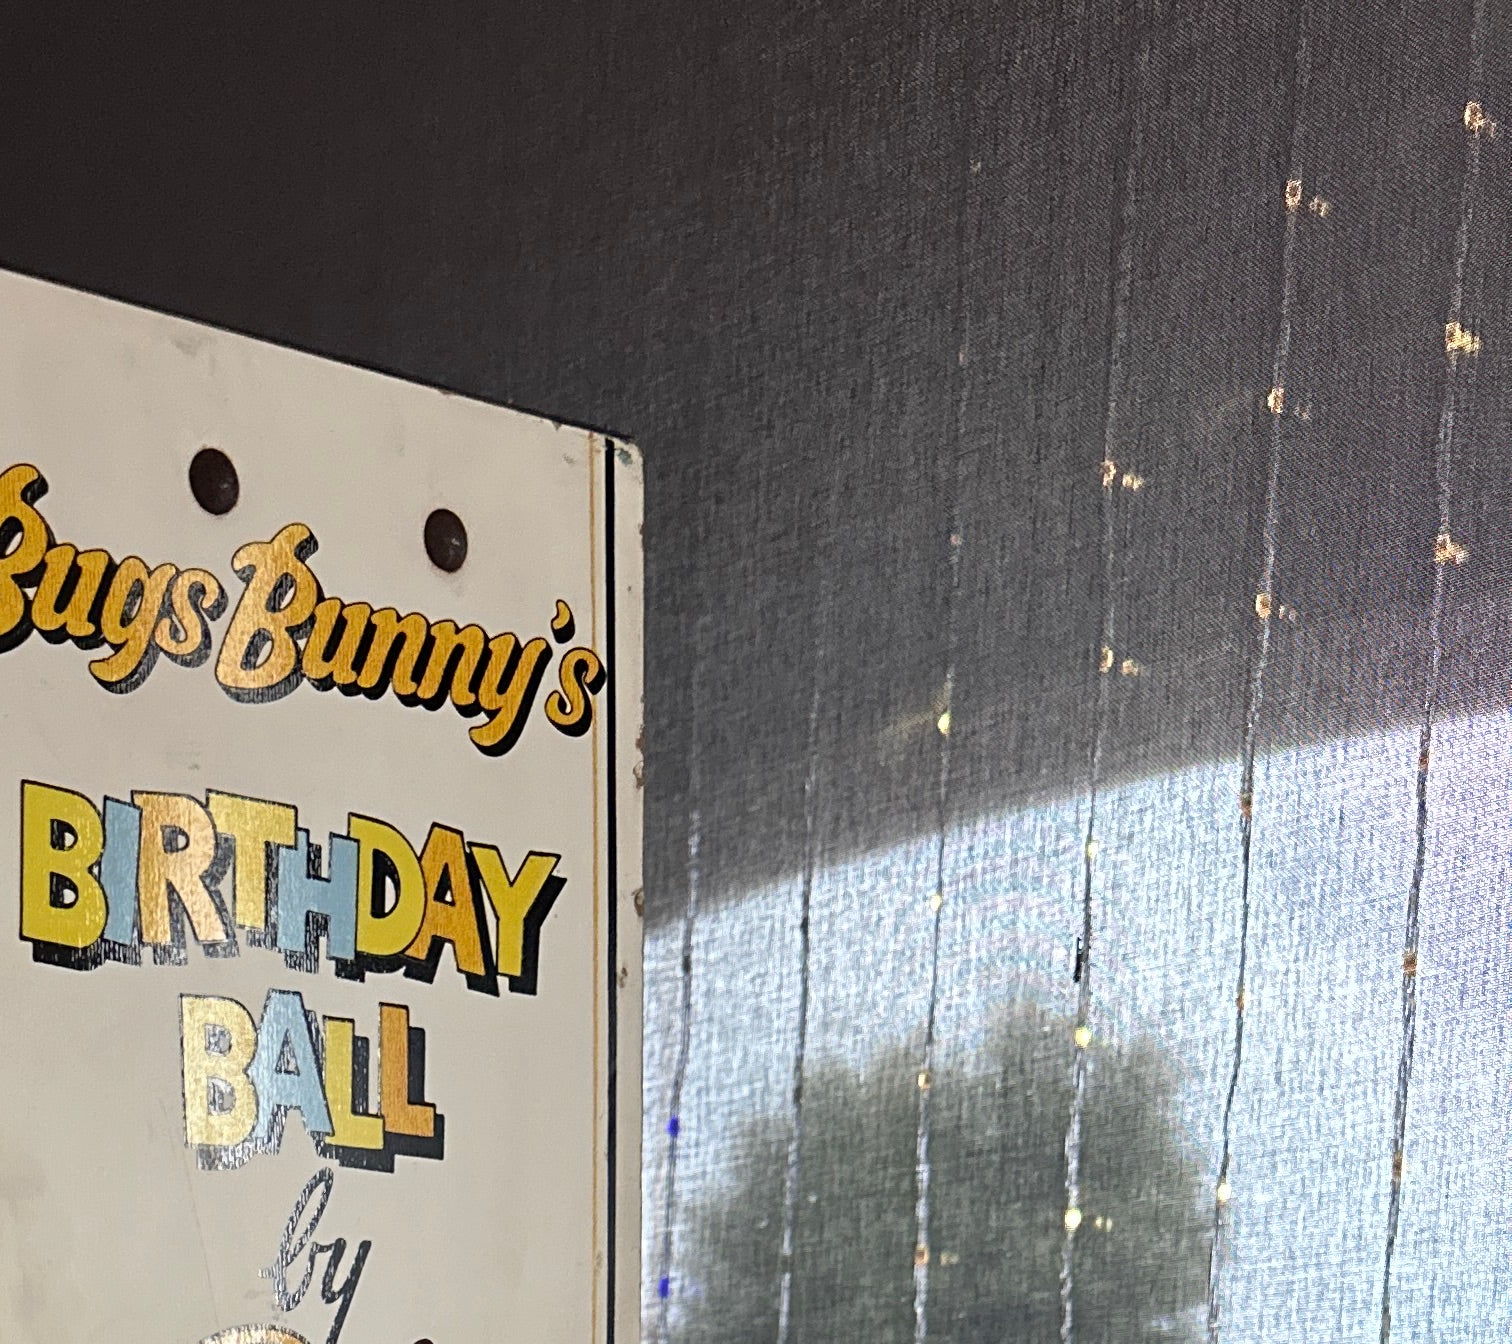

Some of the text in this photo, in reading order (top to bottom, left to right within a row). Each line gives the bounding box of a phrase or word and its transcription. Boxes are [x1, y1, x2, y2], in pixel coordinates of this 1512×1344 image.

[213, 522, 606, 758] Bunny's
[19, 778, 568, 997] BIRTHDAY
[179, 988, 446, 1174] BALL
